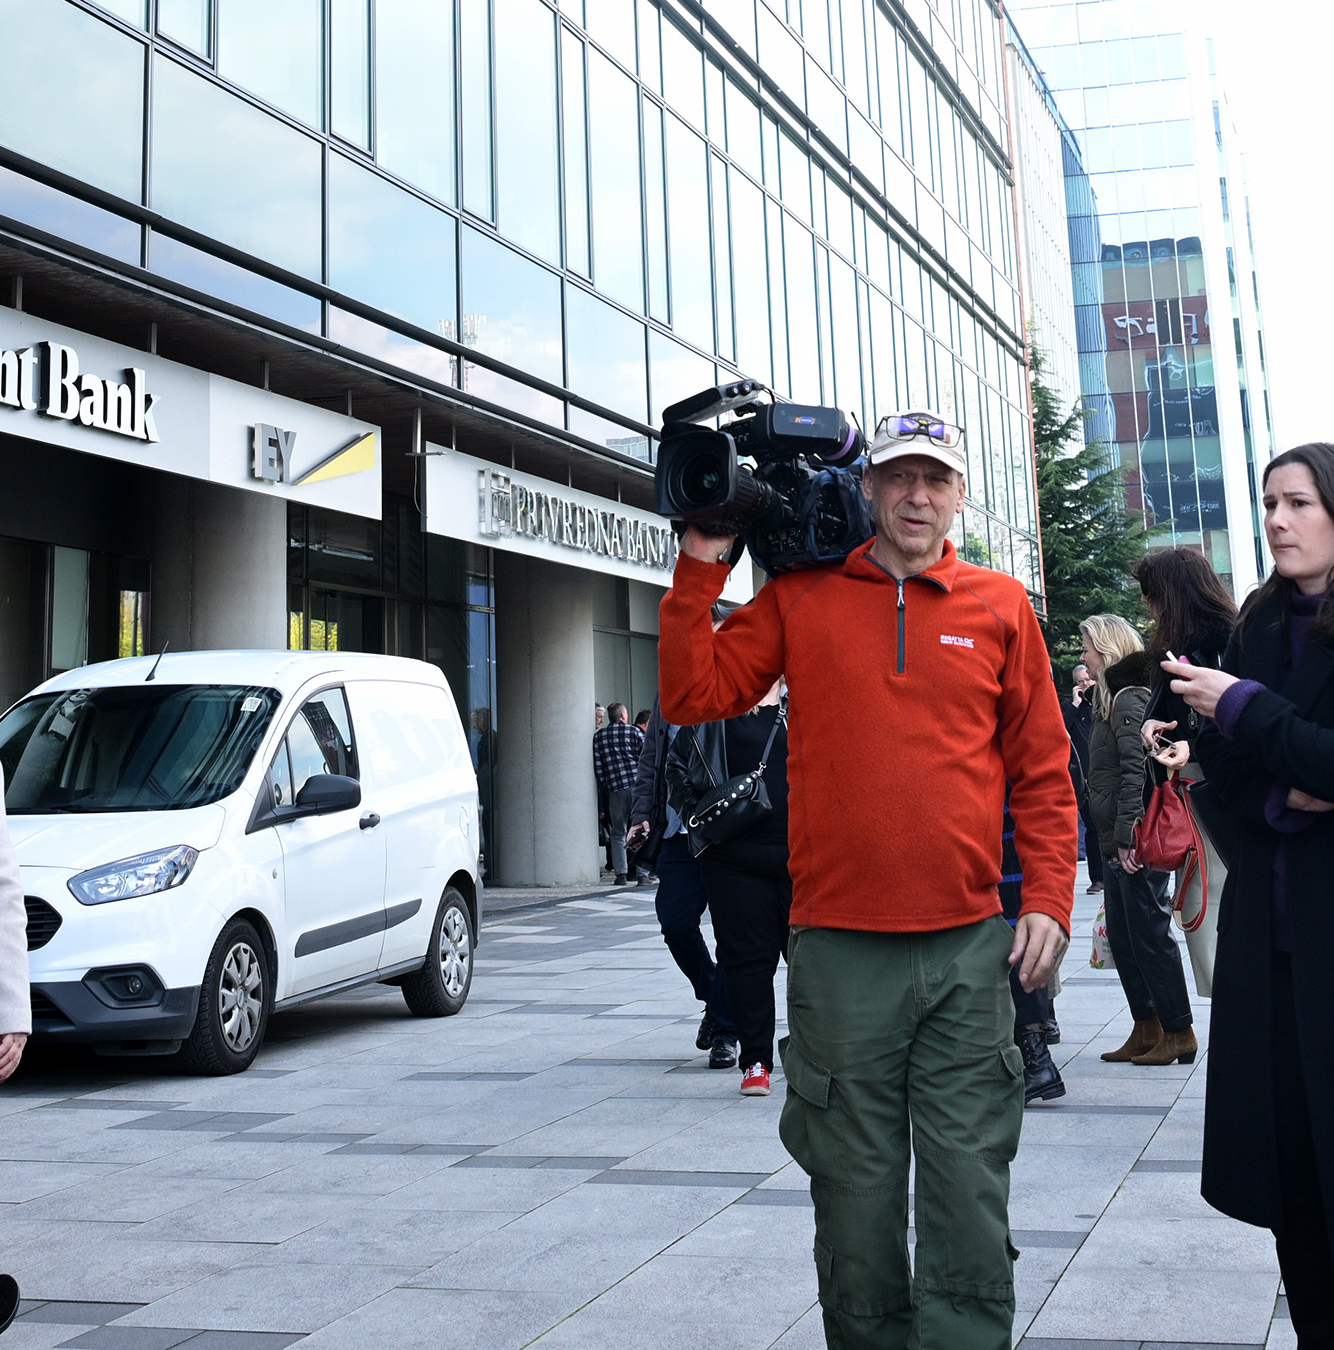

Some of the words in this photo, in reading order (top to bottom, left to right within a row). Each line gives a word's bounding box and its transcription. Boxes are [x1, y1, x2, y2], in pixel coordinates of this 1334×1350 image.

[38, 341, 161, 444] Bank
[254, 422, 297, 483] EY
[512, 484, 622, 558] PRIVREDNA
